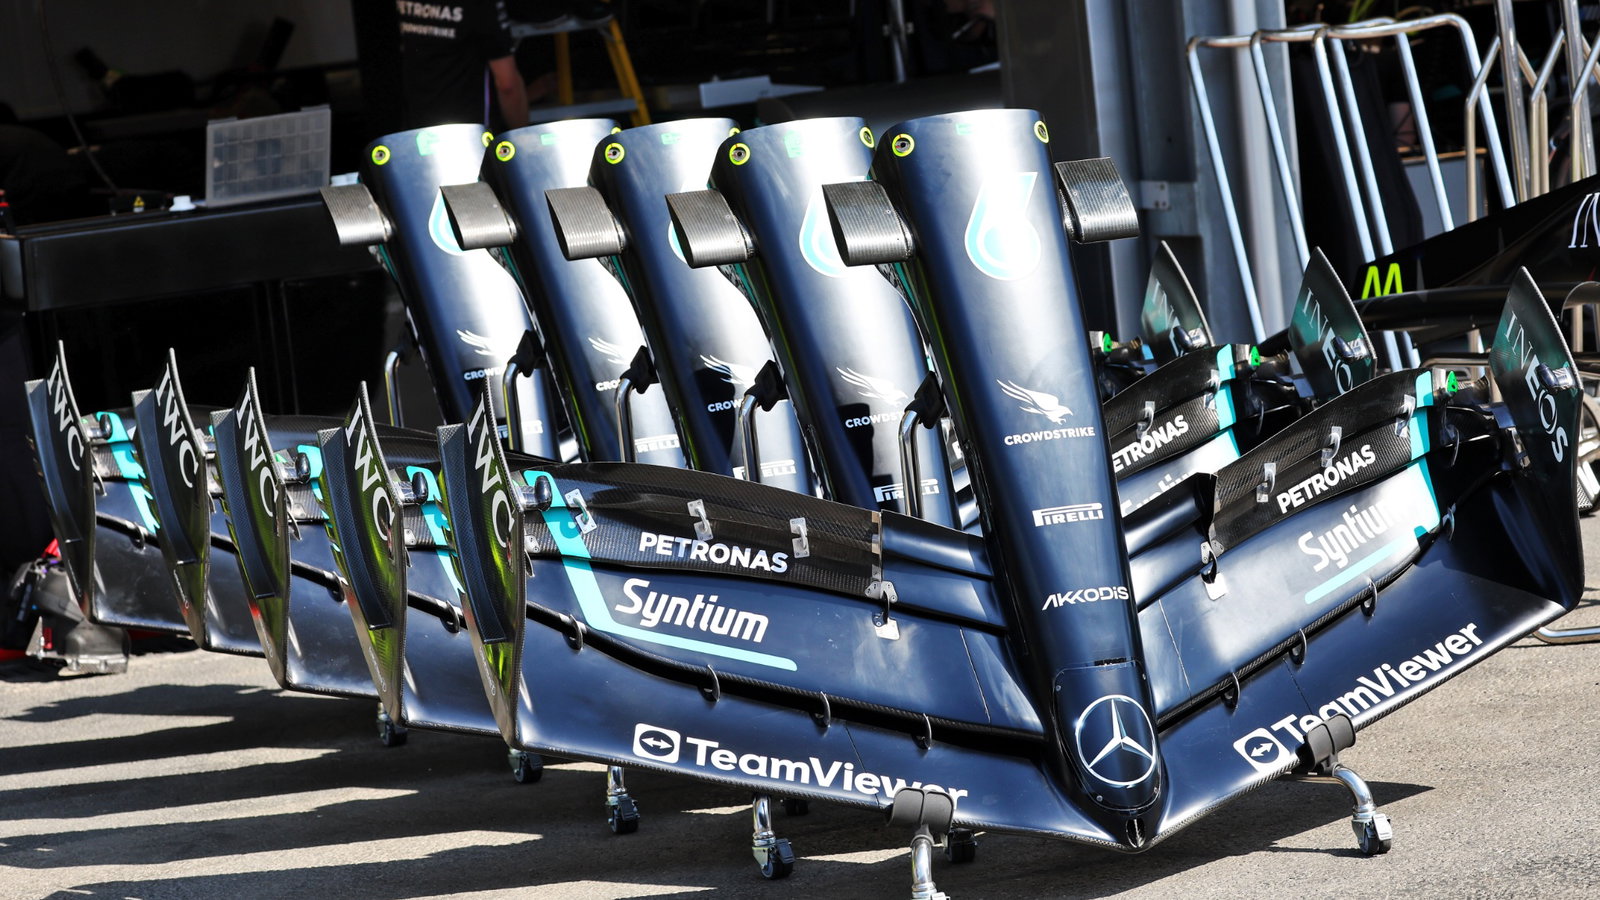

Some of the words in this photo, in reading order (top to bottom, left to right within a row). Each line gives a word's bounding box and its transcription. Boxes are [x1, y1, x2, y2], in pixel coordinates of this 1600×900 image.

[1302, 287, 1353, 395] INEO
[1505, 310, 1569, 463] INEOS
[47, 354, 84, 472] IWC
[155, 363, 199, 488] IWC
[236, 383, 279, 518] IWC
[1004, 426, 1096, 446] CROWDSTRIKE
[1112, 415, 1189, 473] ETRONAS
[345, 398, 396, 541] IWC
[466, 392, 515, 549] IWC
[1032, 502, 1104, 527] PIRELLI
[1276, 444, 1377, 514] PETRONAS
[638, 532, 789, 573] PETRONAS
[615, 577, 769, 644] Syntium
